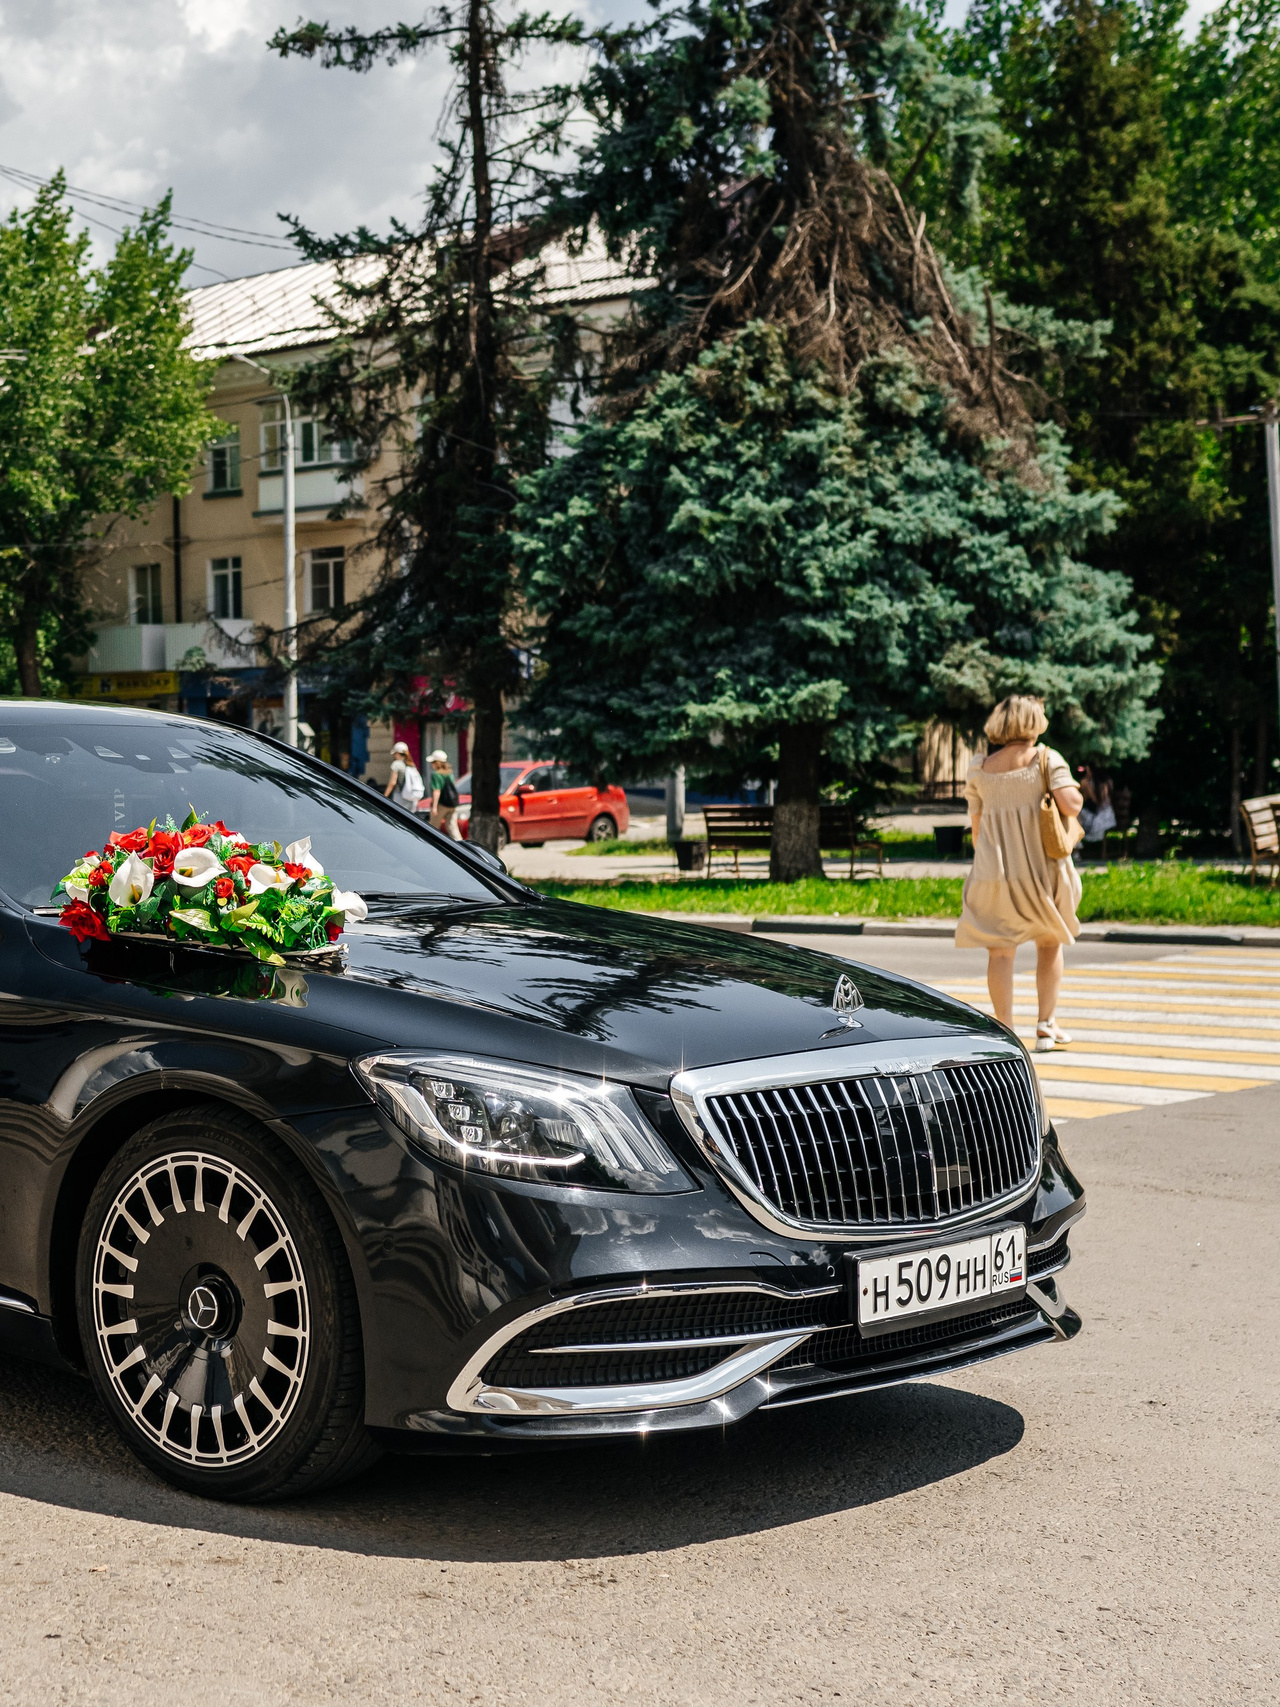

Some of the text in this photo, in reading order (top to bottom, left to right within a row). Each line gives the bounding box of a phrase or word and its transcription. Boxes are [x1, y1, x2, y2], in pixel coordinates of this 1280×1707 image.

[872, 1235, 1016, 1314] Н509НН 61
[992, 1271, 1009, 1286] RUS
